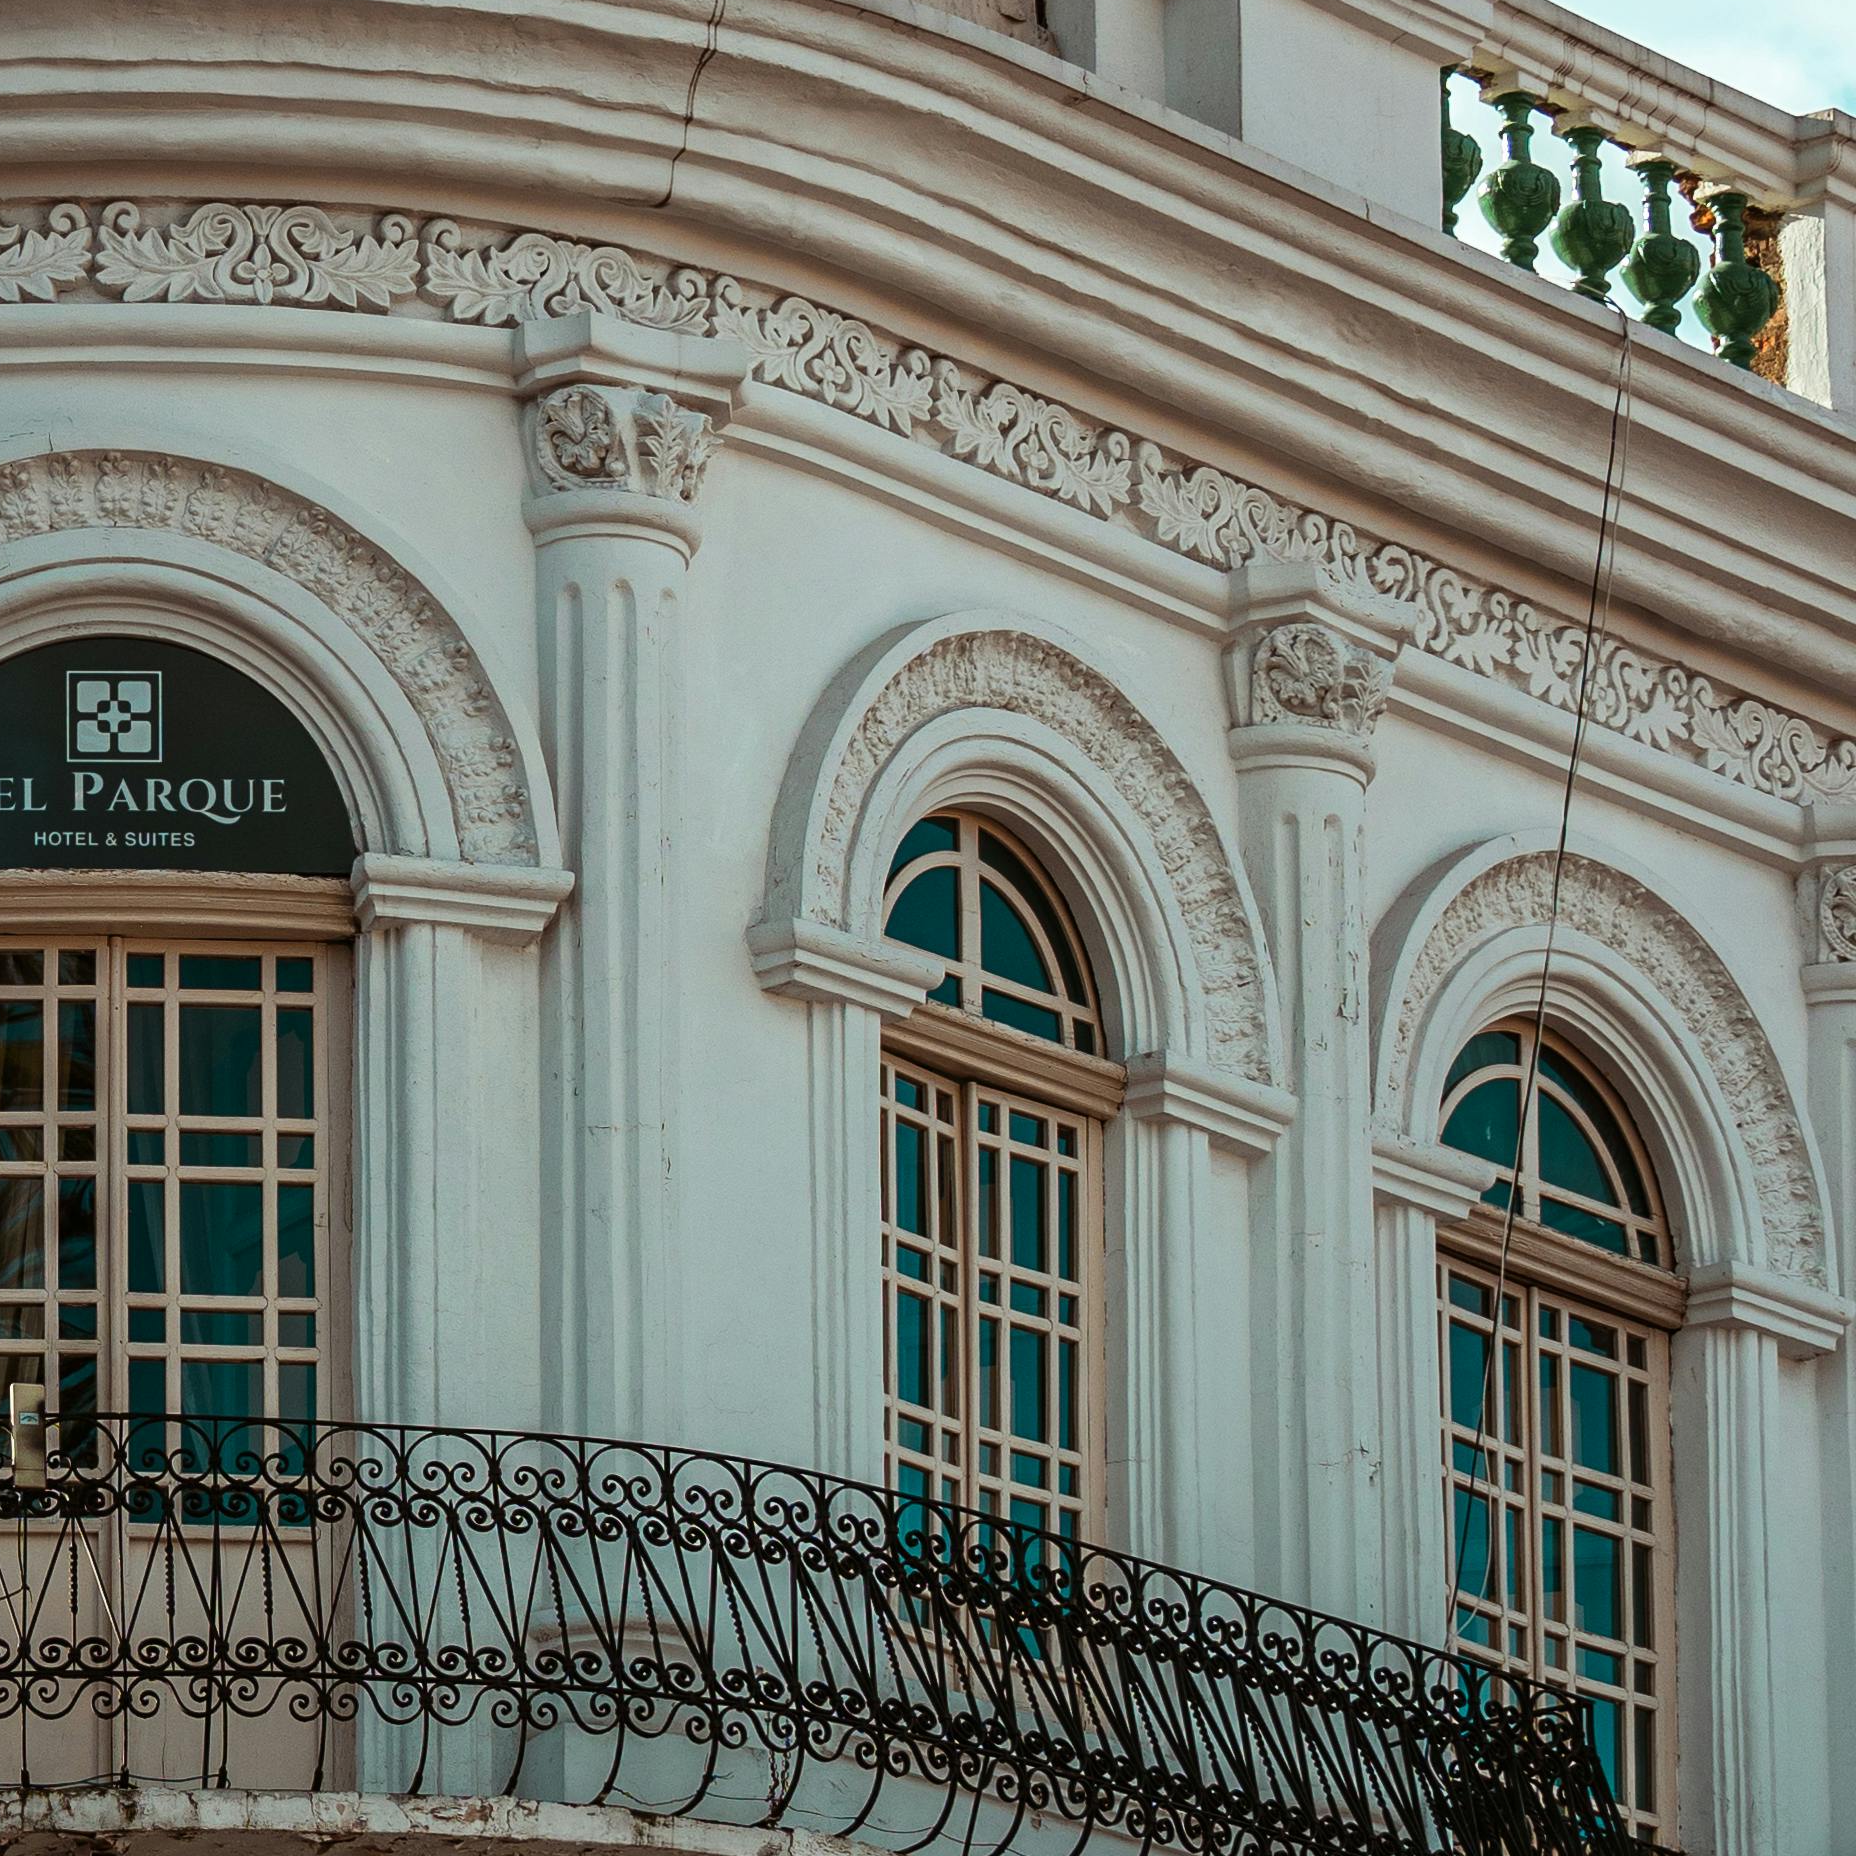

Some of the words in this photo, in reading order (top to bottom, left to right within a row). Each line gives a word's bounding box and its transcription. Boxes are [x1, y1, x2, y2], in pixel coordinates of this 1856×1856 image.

[72, 771, 287, 825] PARQUE
[34, 831, 99, 847] HOTEL
[105, 832, 118, 847] &
[125, 832, 196, 847] SUITES
